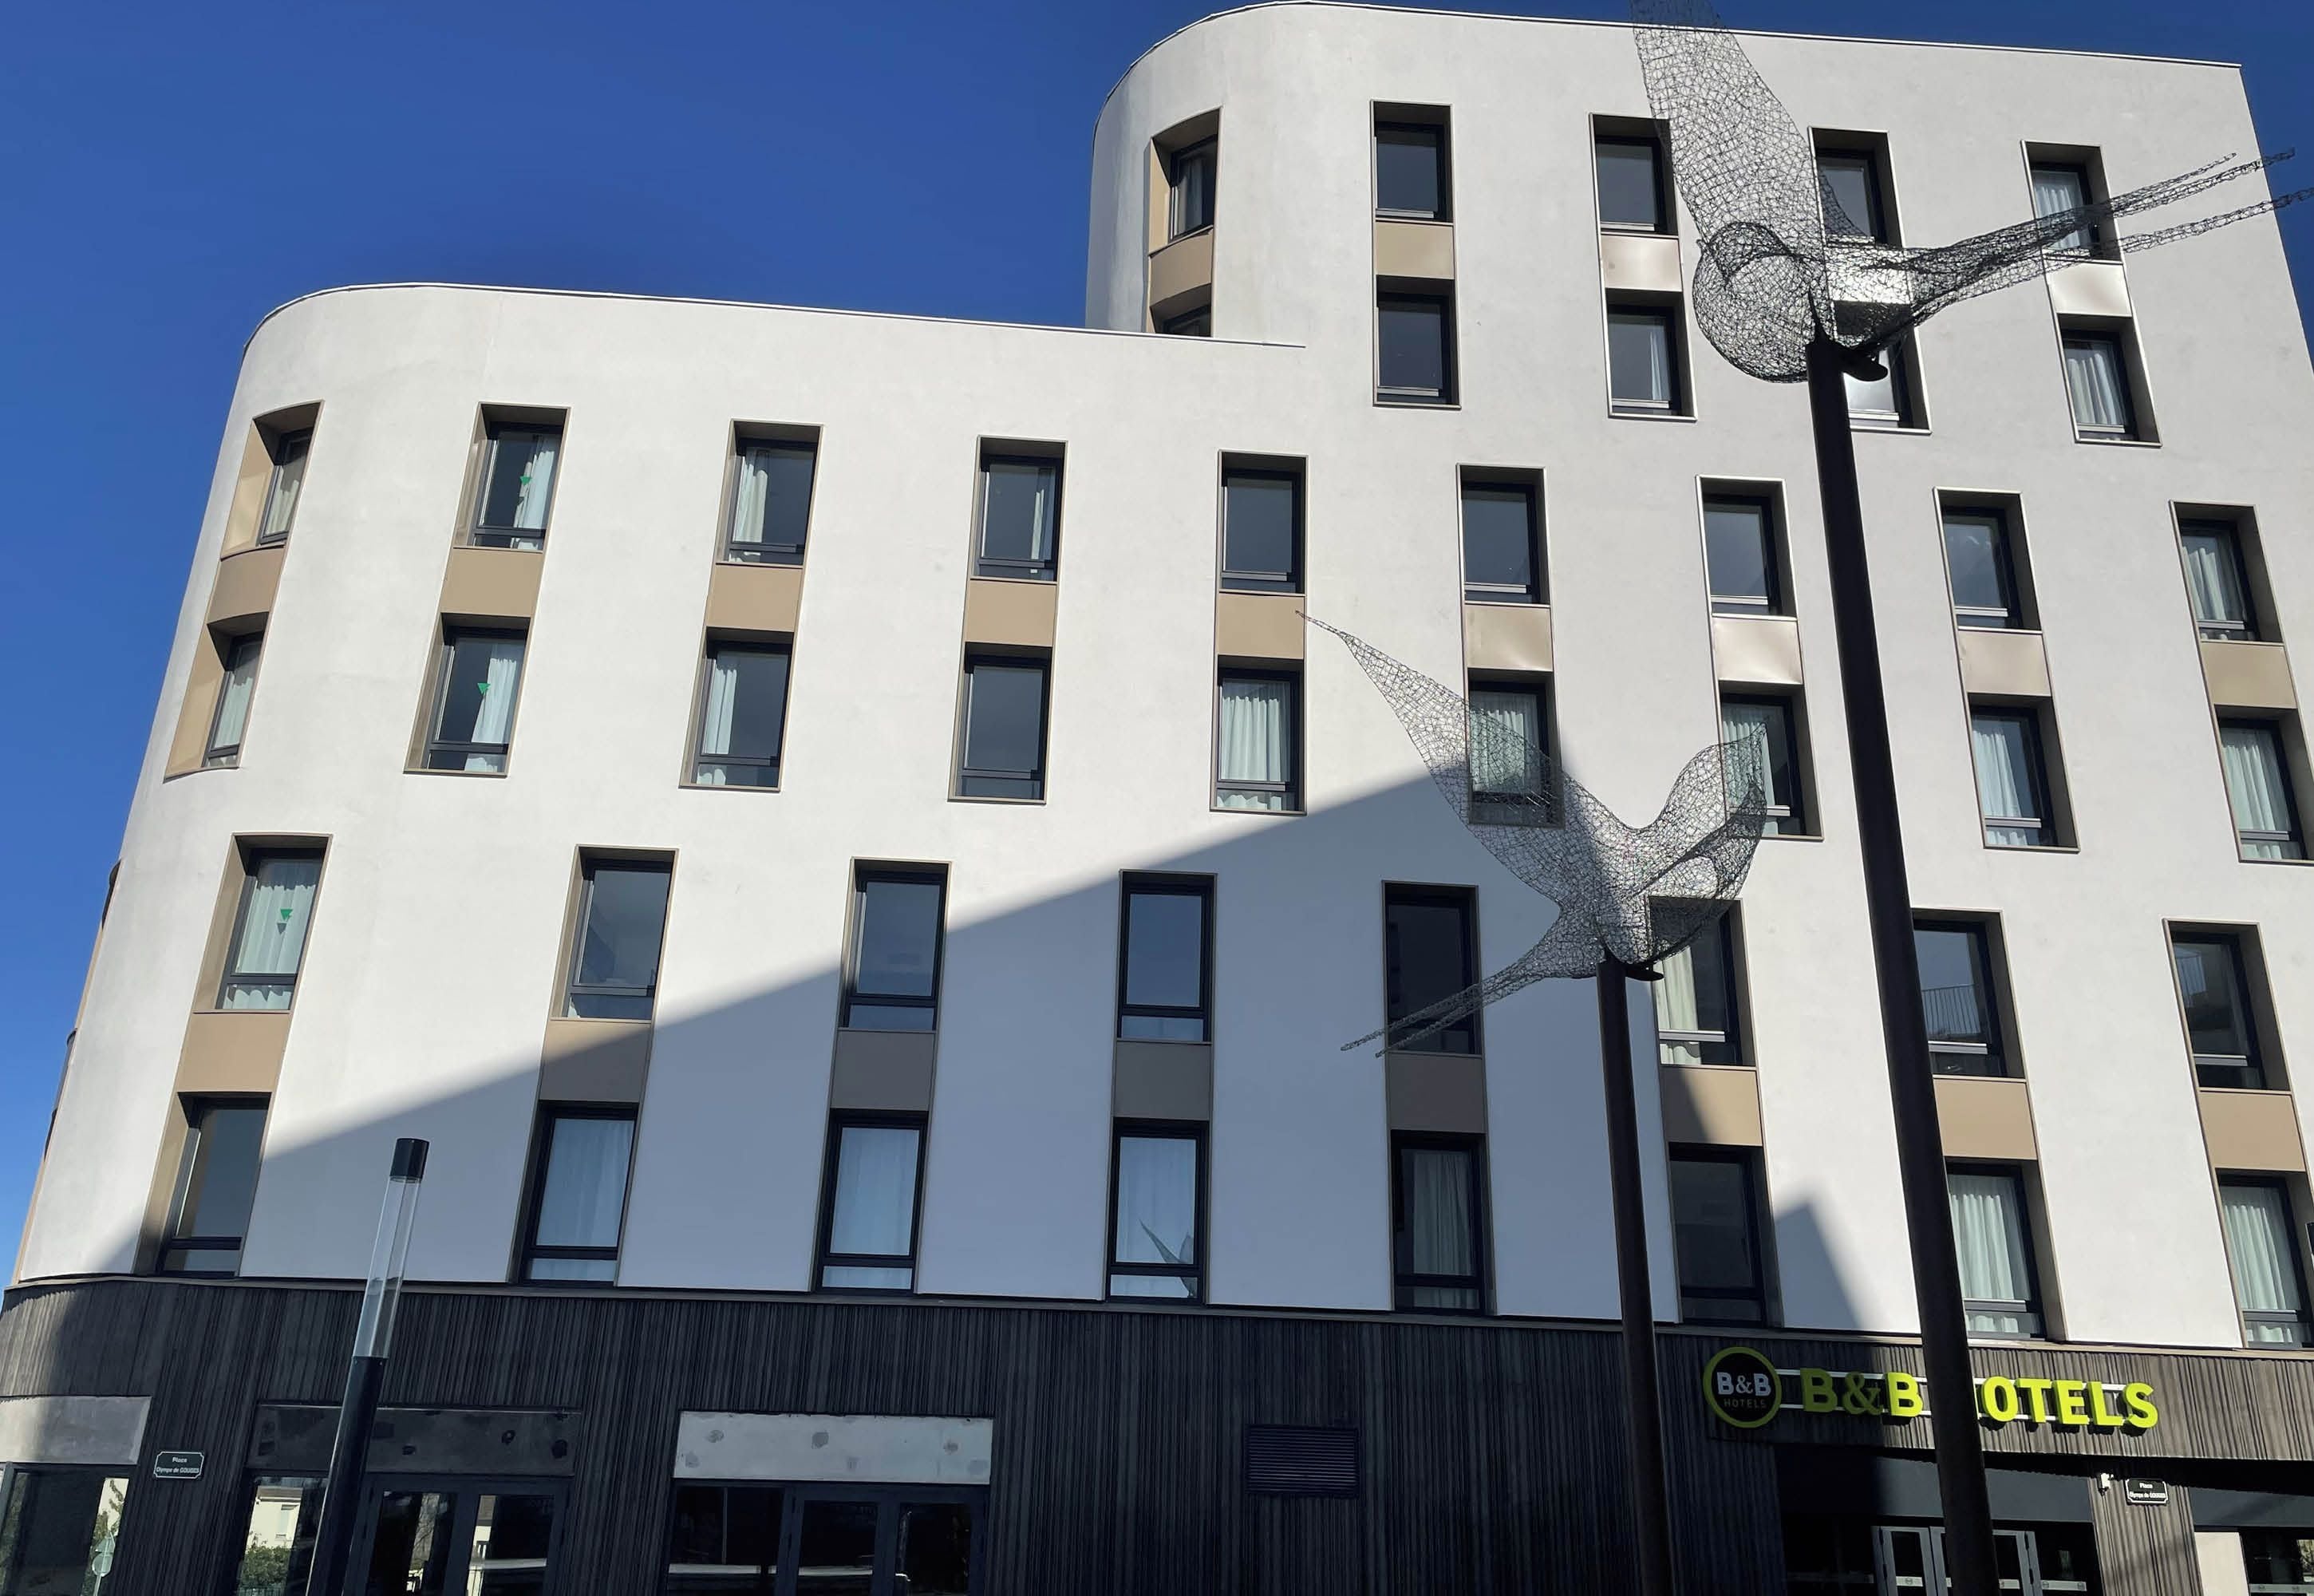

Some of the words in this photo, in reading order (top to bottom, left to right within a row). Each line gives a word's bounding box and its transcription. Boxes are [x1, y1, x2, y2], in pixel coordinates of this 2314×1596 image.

[1716, 1372, 1771, 1396] B&B
[1724, 1398, 1767, 1409] HOTELS
[1800, 1368, 1924, 1417] B&B
[1972, 1376, 2158, 1428] OTELS
